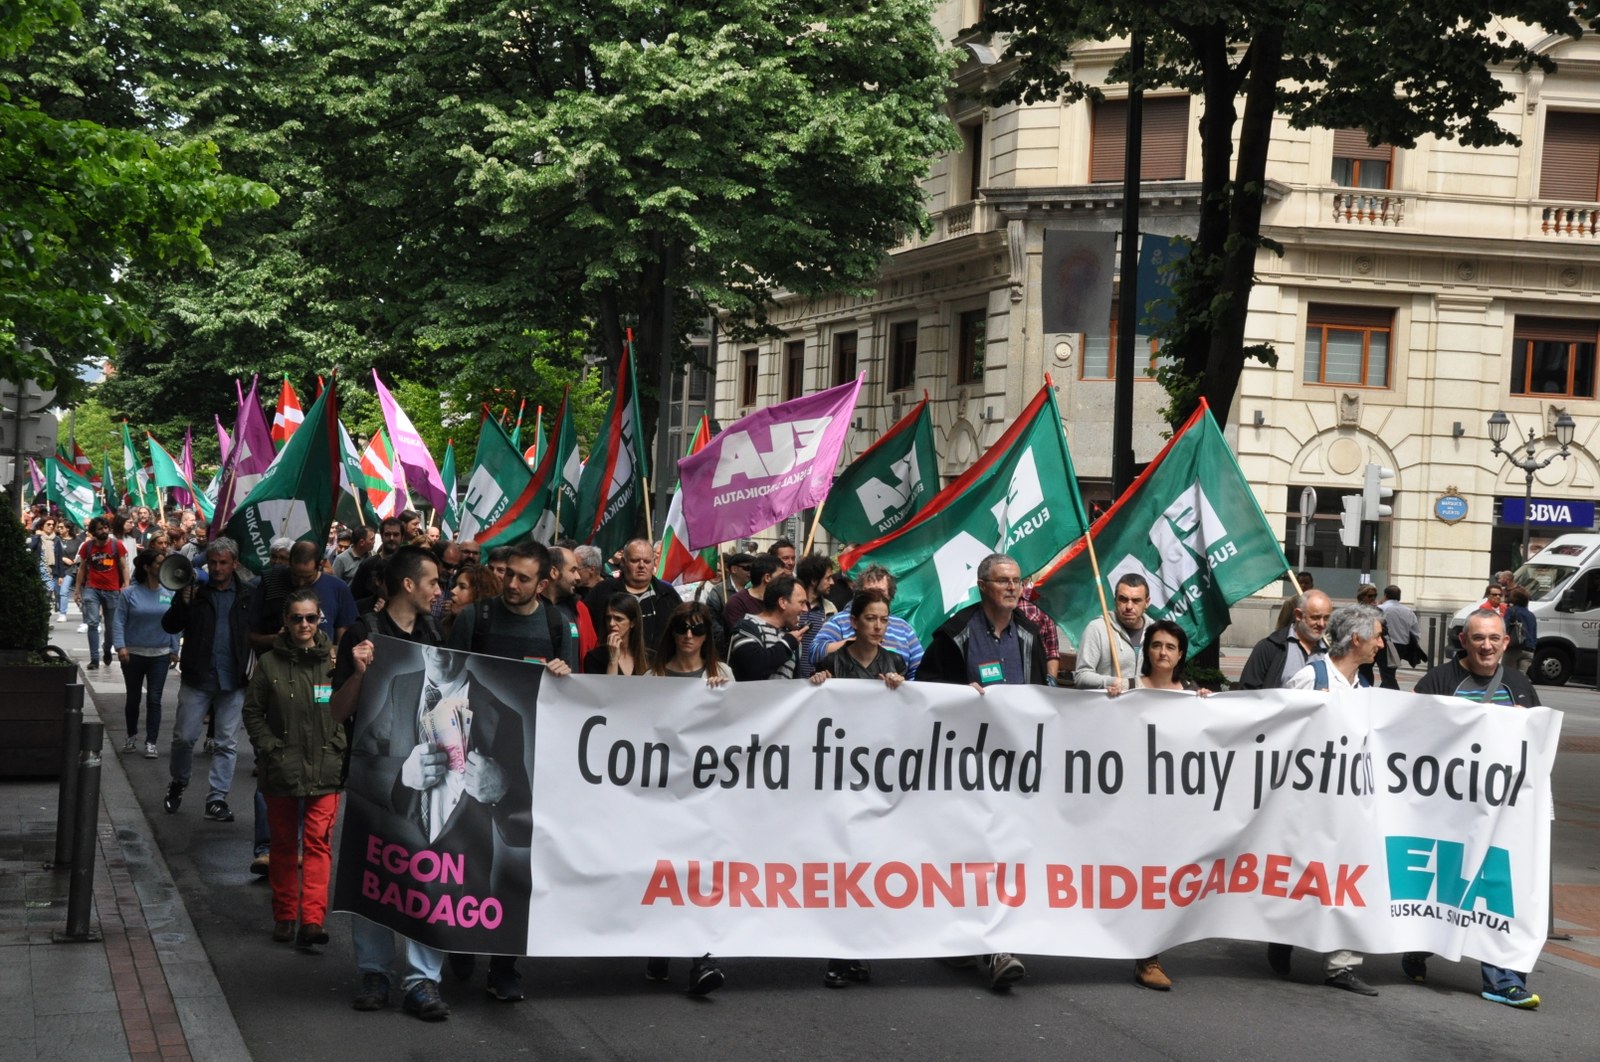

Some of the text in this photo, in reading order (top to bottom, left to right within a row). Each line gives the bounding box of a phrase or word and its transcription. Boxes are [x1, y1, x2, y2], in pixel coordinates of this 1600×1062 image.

[1529, 504, 1572, 523] BBVA
[1581, 621, 1600, 629] arr
[577, 715, 1528, 811] Con esta fiscalidad no hay justicia social
[366, 834, 465, 885] EGON
[640, 852, 1370, 910] AURREKONTU BIDEGABEAK
[1384, 835, 1515, 919] ELA
[361, 870, 503, 930] BADAGO
[1390, 903, 1443, 920] EUSKAL
